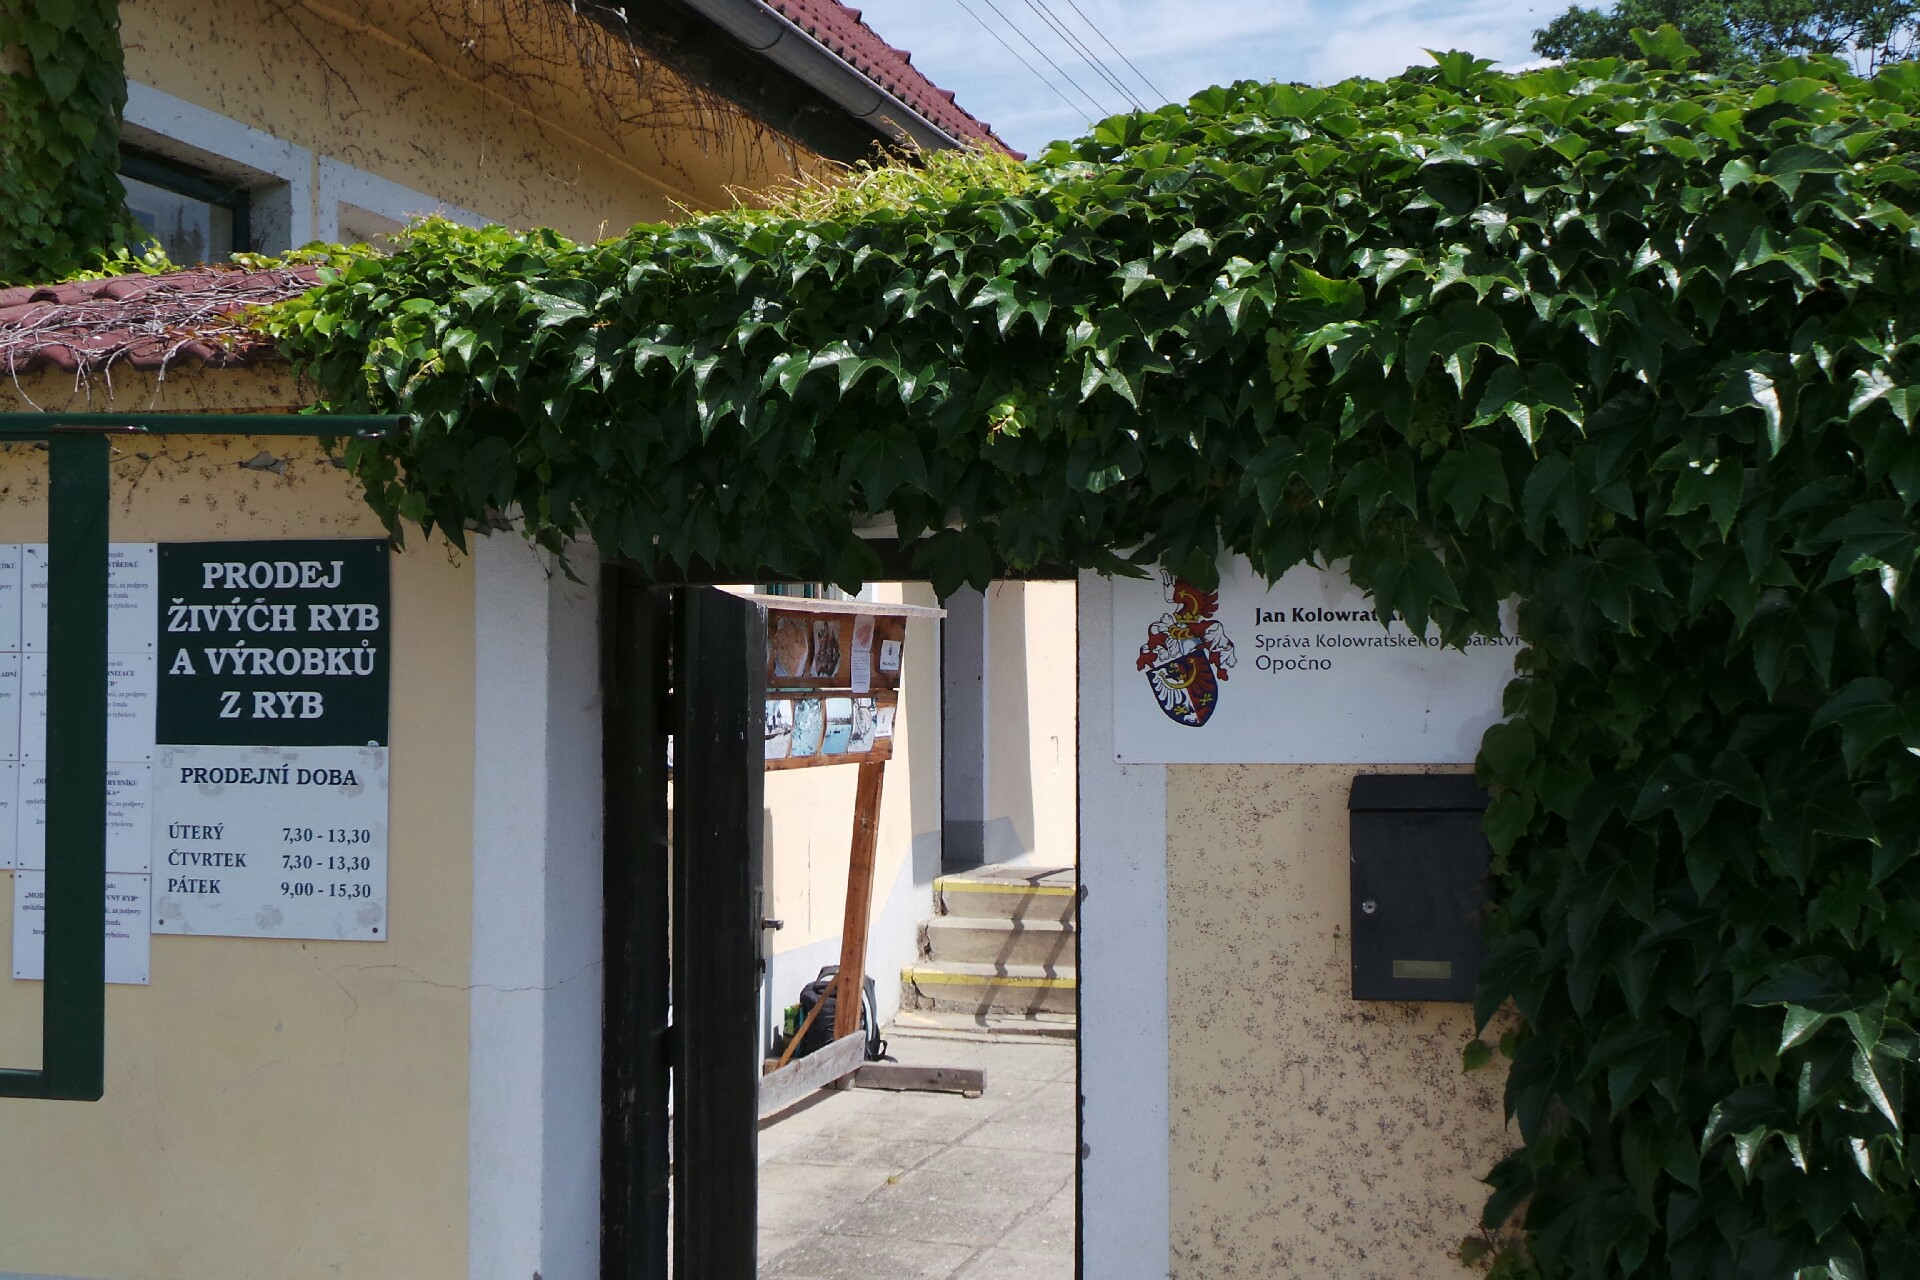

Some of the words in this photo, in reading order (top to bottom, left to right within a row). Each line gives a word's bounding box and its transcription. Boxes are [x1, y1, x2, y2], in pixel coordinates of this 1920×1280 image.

[203, 561, 344, 589] PRODEJ
[308, 603, 379, 632] RYB
[1255, 607, 1286, 627] Jan
[1255, 633, 1311, 651] Správa
[169, 647, 196, 675] A
[204, 639, 377, 676] VÝROBKŮ
[1255, 655, 1332, 674] Opočno
[219, 691, 242, 719] Z
[252, 691, 324, 719] RYB
[180, 763, 289, 785] PRODEJNÍ
[296, 768, 358, 786] DOBA
[168, 821, 224, 840] ÚTERÝ
[282, 827, 313, 844] 7,30
[328, 828, 371, 845] 13,30
[168, 848, 247, 867] ČTVRTEK
[282, 855, 313, 871] 7,30
[327, 856, 371, 872] 13,30
[168, 875, 221, 894] PÁTEK
[280, 881, 314, 899] 9,00
[329, 884, 371, 900] 15,30
